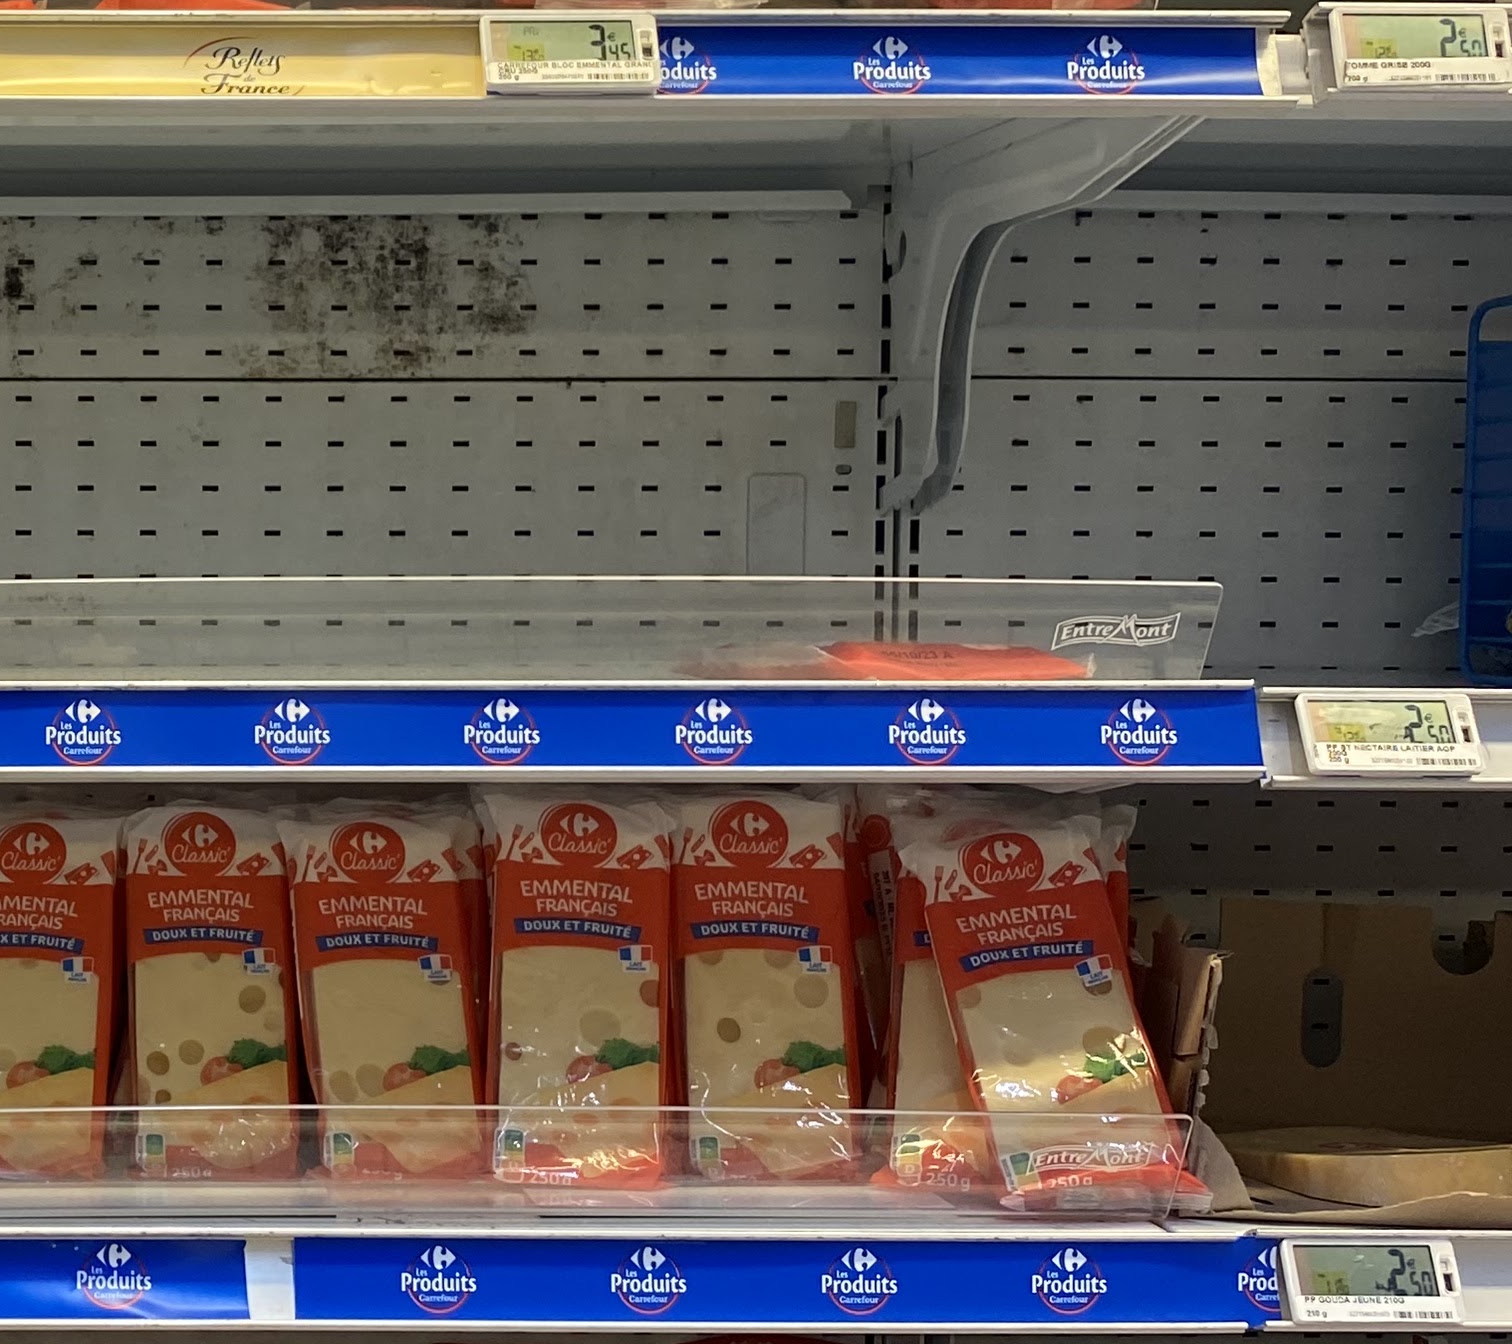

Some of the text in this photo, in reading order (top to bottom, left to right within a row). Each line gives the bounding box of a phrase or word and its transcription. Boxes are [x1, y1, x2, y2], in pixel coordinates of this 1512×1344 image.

[206, 44, 284, 75] Reflets
[869, 55, 881, 64] Les
[853, 61, 931, 82] Produits
[200, 71, 290, 96] France
[871, 80, 911, 90] Carrefour
[1061, 615, 1172, 644] EntreMont
[464, 724, 540, 745] Produits
[480, 720, 492, 728] Les
[1101, 724, 1177, 745] Produits
[1117, 720, 1129, 728] Les
[482, 745, 522, 755] Carrefour
[1119, 745, 1159, 755] Carrefour
[694, 881, 809, 904] EMMENTAL
[712, 900, 794, 918] FRANÇAIS
[955, 903, 1077, 933] EMMENTAL
[700, 921, 810, 939] DOUX ET FRUITÉ
[977, 922, 1064, 946] FRANÇAIS
[969, 941, 1084, 967] DOUX ET FRUITÉ
[1034, 1146, 1143, 1169] EntreMont
[92, 1265, 104, 1274] Les
[76, 1269, 152, 1293] Produits
[94, 1291, 134, 1301] Carrefour
